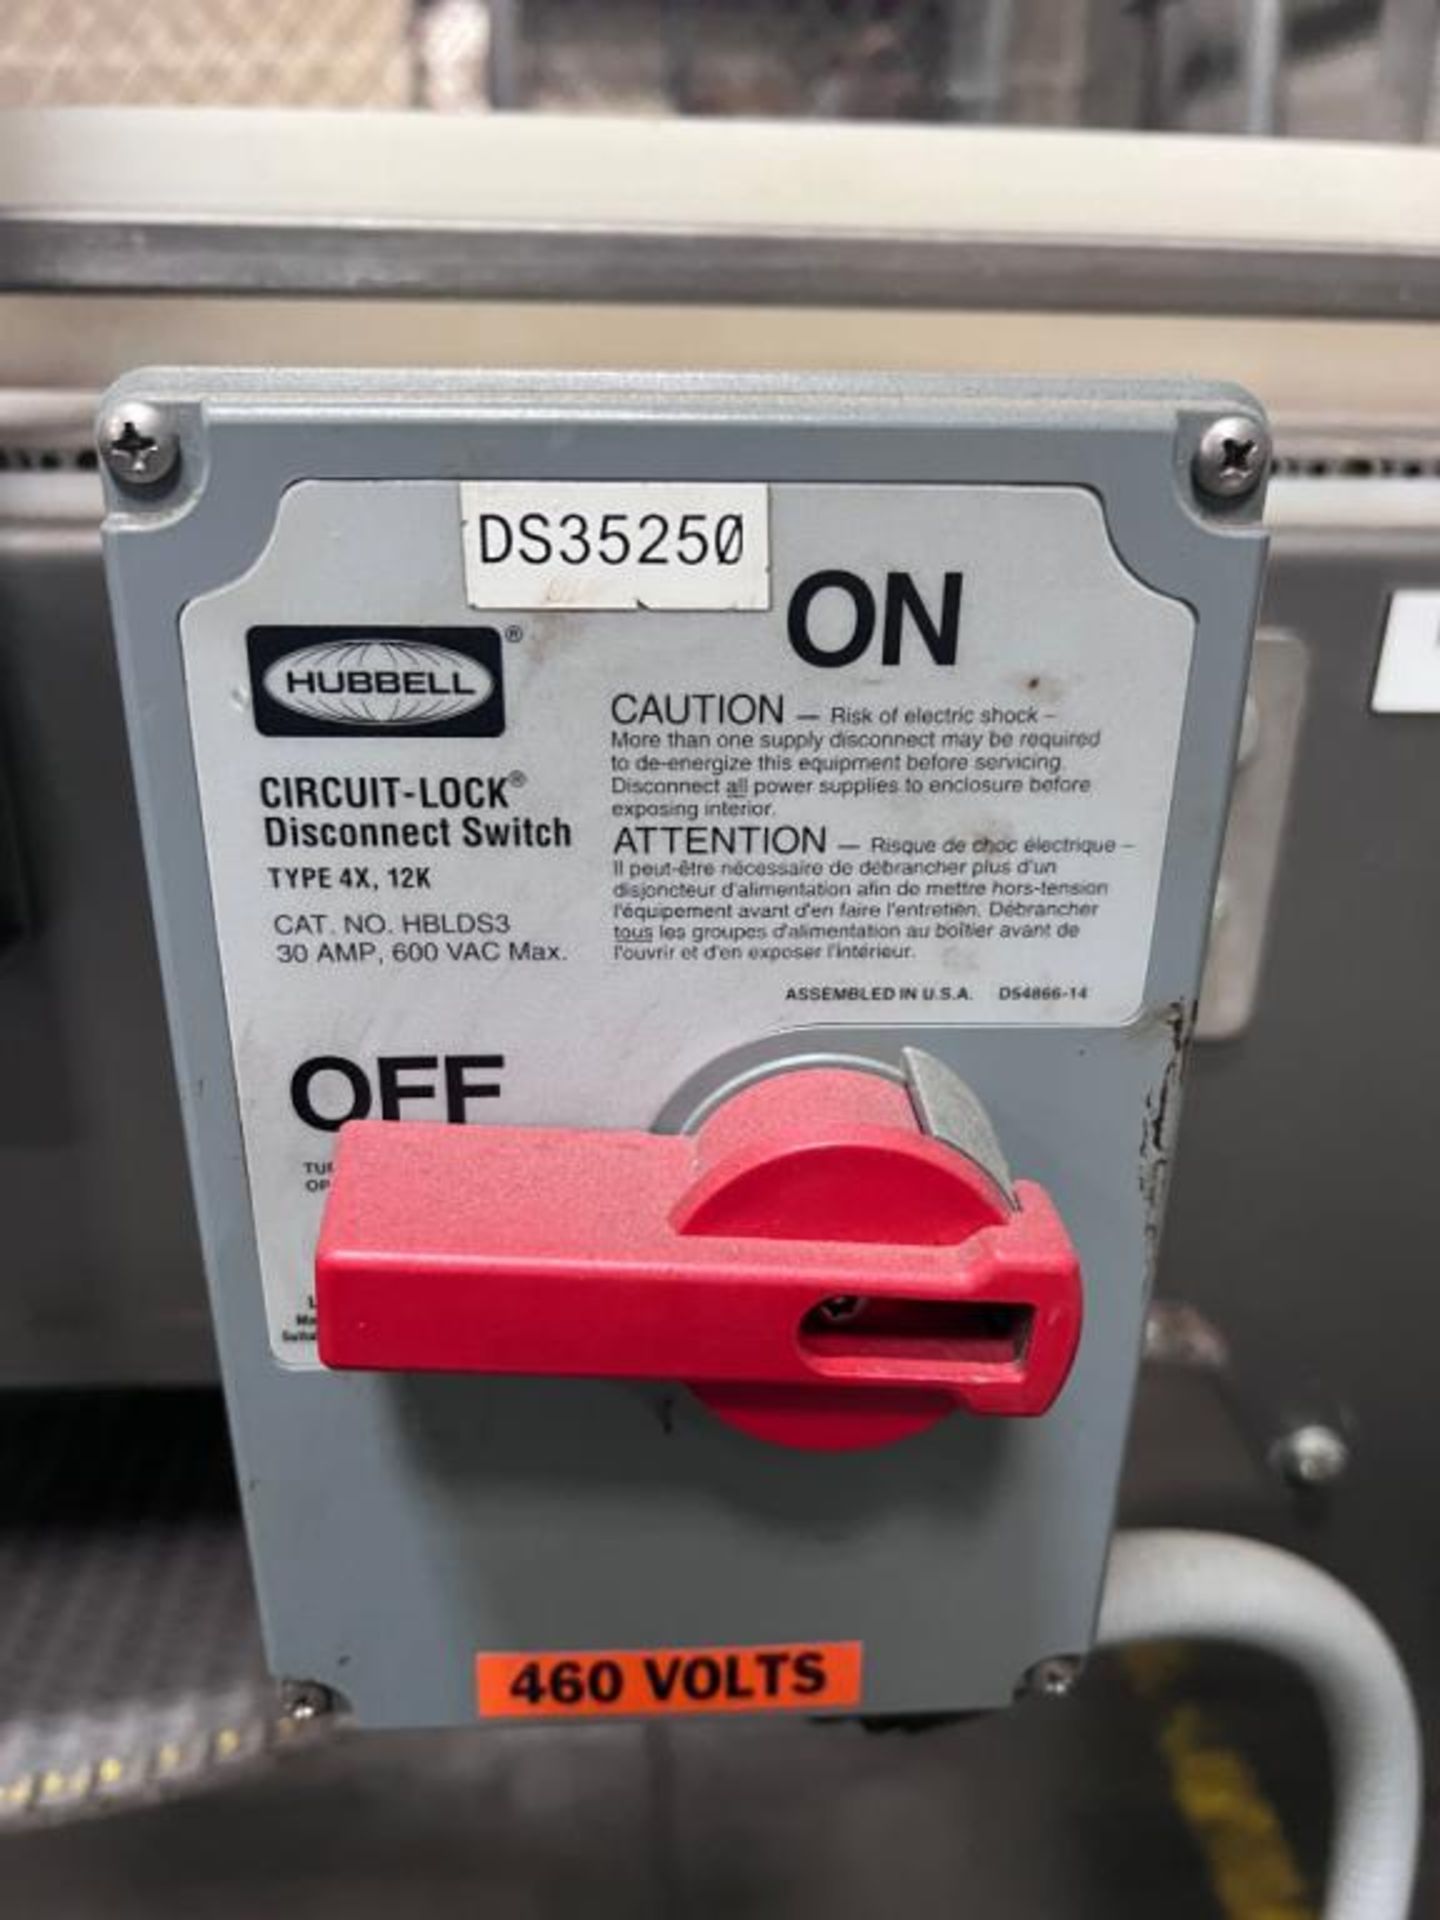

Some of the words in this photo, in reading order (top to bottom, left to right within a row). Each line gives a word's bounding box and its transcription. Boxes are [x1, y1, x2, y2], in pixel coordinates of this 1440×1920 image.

[478, 513, 744, 566] DS35250
[787, 569, 963, 668] ON
[286, 670, 477, 697] HUBBELL
[611, 693, 784, 725] CAUTION
[830, 706, 873, 725] Risk
[879, 707, 898, 725] of
[904, 707, 974, 725] electric
[980, 706, 1038, 724] shock
[611, 730, 662, 749] More
[667, 730, 711, 749] than
[716, 734, 754, 749] one
[760, 730, 824, 752] supply
[829, 731, 936, 749] disconnect
[941, 733, 983, 751] may
[988, 731, 1014, 748] be
[1019, 730, 1102, 750] required
[611, 755, 630, 772] to
[635, 754, 752, 775] de-energize
[758, 754, 793, 772] this
[799, 754, 901, 774] equipment
[906, 753, 969, 772] before
[611, 777, 720, 794] Disconnect
[726, 777, 749, 798] all
[754, 780, 813, 798] power
[819, 777, 899, 798] supplies
[905, 777, 923, 794] to
[929, 777, 1023, 794] enclosure
[1029, 776, 1091, 793] before
[611, 801, 699, 821] exposing
[264, 816, 451, 848] Disconnect
[462, 815, 572, 848] Switch
[613, 825, 827, 855] ATTENTION
[871, 836, 936, 855] Risque
[942, 836, 966, 853] de
[972, 836, 1018, 853] choc
[1023, 835, 1117, 855] électrique
[268, 866, 332, 889] TYPE
[339, 866, 379, 892] 4X,
[388, 866, 432, 889] 12K
[829, 860, 853, 876] de
[971, 860, 1011, 878] plus
[613, 882, 716, 901] disjoncteur
[857, 881, 892, 897] afin
[896, 881, 921, 897] de
[926, 881, 987, 897] mettre
[992, 880, 1109, 897] hors-tension
[737, 903, 790, 919] avant
[839, 901, 882, 918] faire
[274, 914, 337, 935] CAT.
[344, 914, 393, 934] NO.
[402, 912, 511, 935] HBLDS3
[614, 925, 654, 944] tous
[658, 924, 686, 940] les
[692, 926, 768, 944] groupes
[906, 924, 929, 939] au
[999, 923, 1052, 939] avant
[1056, 922, 1080, 938] de
[277, 943, 309, 964] 30
[316, 942, 384, 966] AMP,
[391, 942, 439, 963] 600
[446, 941, 500, 963] VAC
[509, 942, 568, 962] Max.
[681, 945, 699, 961] et
[747, 946, 822, 964] exposer
[785, 986, 896, 1002] ASSEMBLED
[899, 986, 918, 1002] IN
[922, 986, 974, 1002] U.S.A.
[290, 1054, 505, 1133] OFF
[509, 1659, 625, 1706] 460
[643, 1651, 828, 1701] VOLTS
